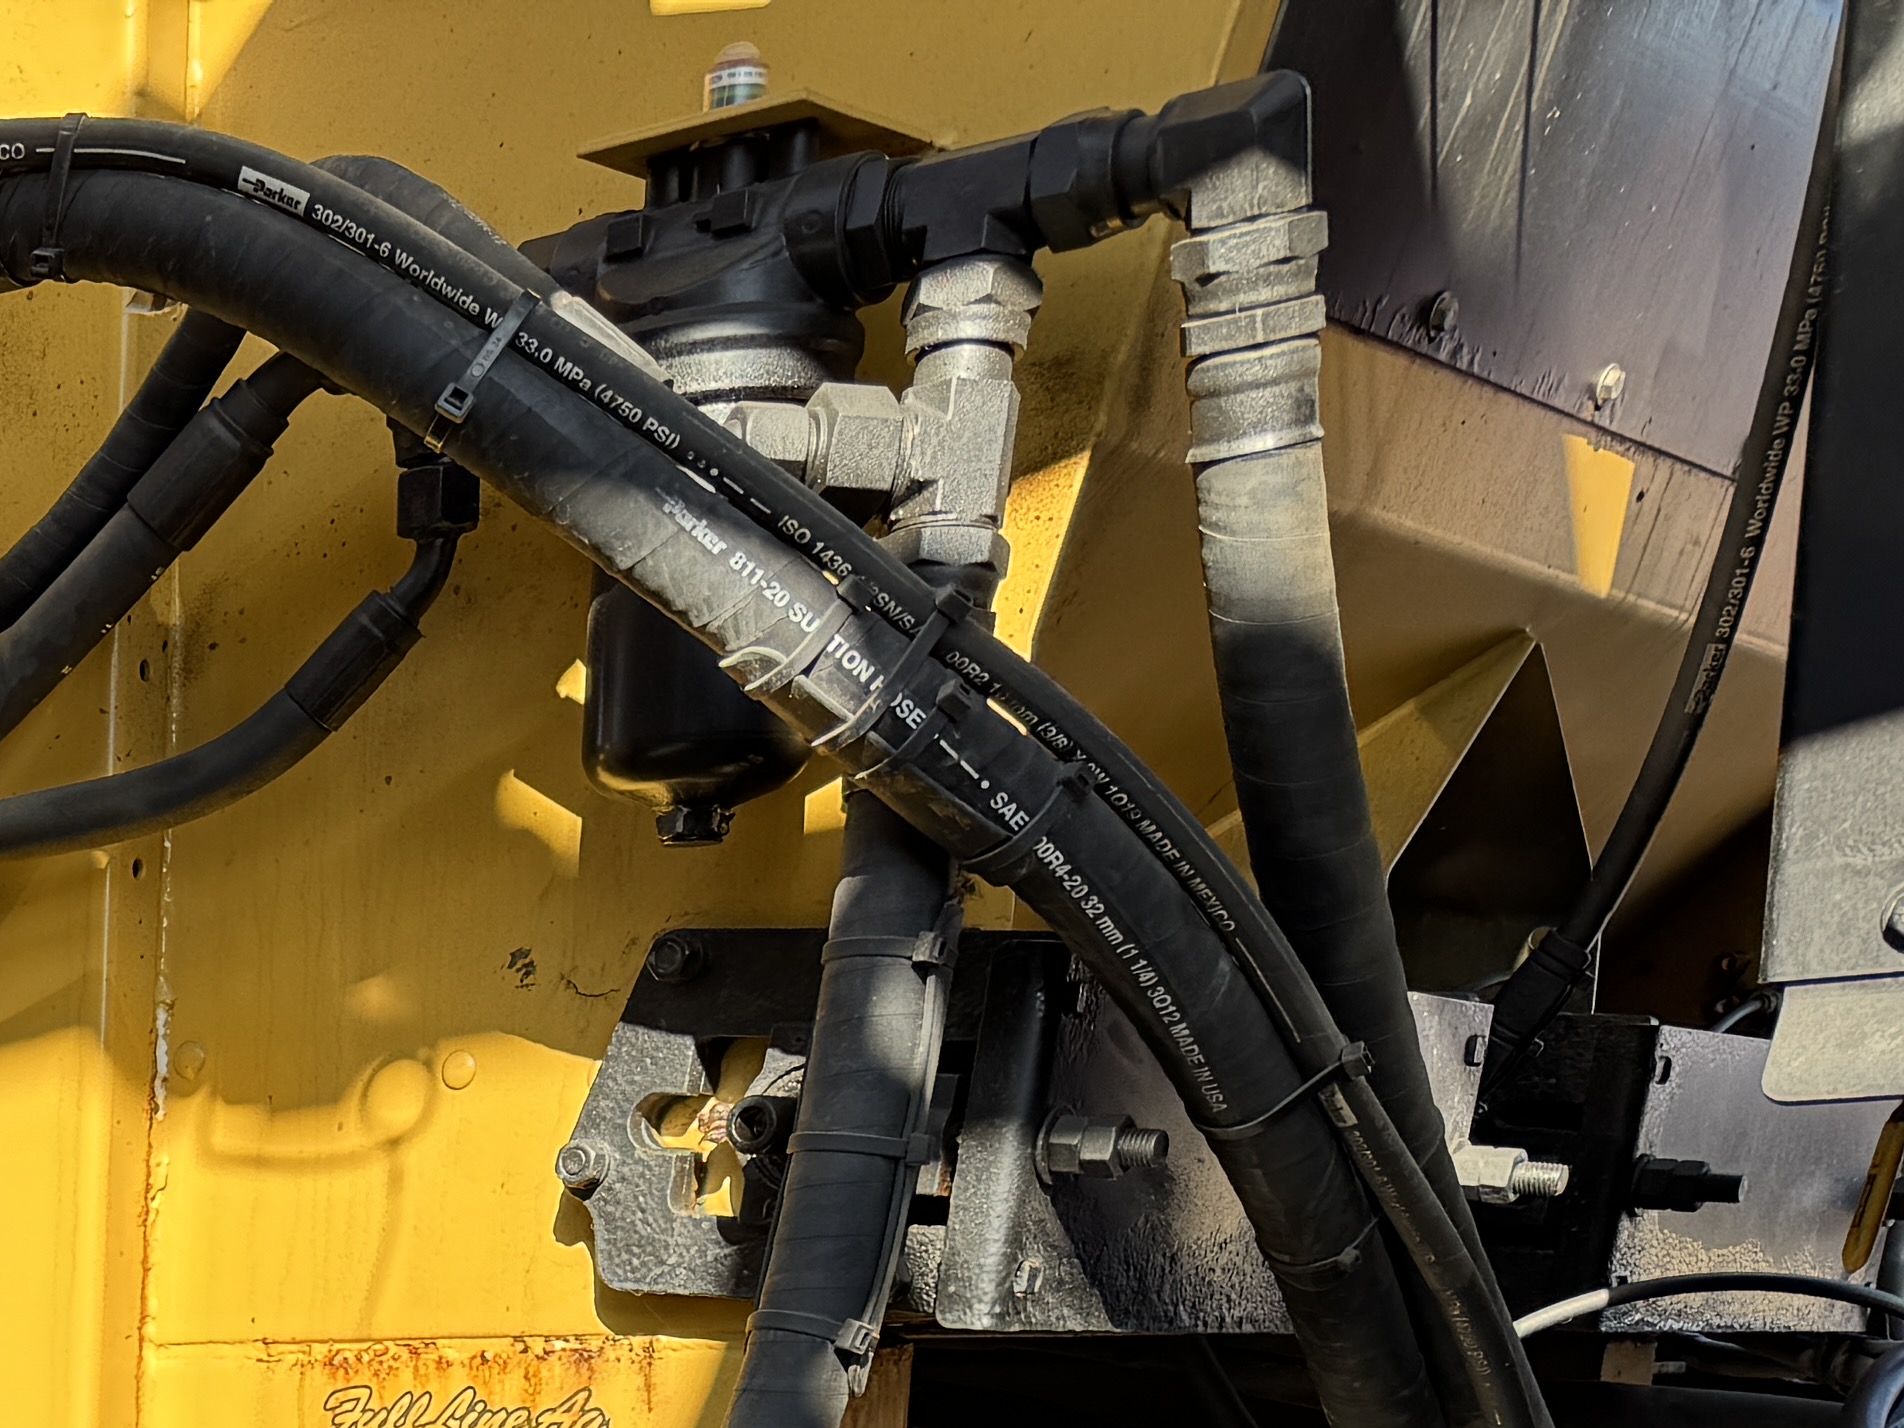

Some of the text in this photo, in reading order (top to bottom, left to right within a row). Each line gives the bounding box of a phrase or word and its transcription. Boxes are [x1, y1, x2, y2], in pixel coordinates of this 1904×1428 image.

[1715, 545, 1755, 638] 302/301-6
[1745, 436, 1785, 538] Worldwide
[1773, 401, 1794, 443] WP
[1794, 308, 1818, 352] MPa
[662, 497, 727, 556] Parker
[253, 178, 302, 211] Parker
[311, 203, 392, 258] 302/301-6
[394, 248, 481, 316] Worldwide
[484, 306, 505, 329] W
[554, 356, 592, 390] MPa
[594, 383, 644, 423] (4750
[642, 416, 681, 449] PSI)
[778, 515, 812, 545] ISO
[1135, 817, 1181, 863] MADE
[1175, 859, 1196, 879] IN
[1187, 876, 1236, 934] MEXICO
[728, 551, 792, 610] 811-20
[787, 603, 876, 685] SUTION
[989, 792, 1031, 834] SAE
[1032, 835, 1090, 899] 0R4-20
[1080, 892, 1105, 918] 32
[1095, 911, 1124, 945] mm
[1147, 984, 1182, 1024] 3Q12
[1169, 1022, 1205, 1067] MADE
[1194, 1066, 1212, 1082] IN
[1200, 1079, 1228, 1113] USA
